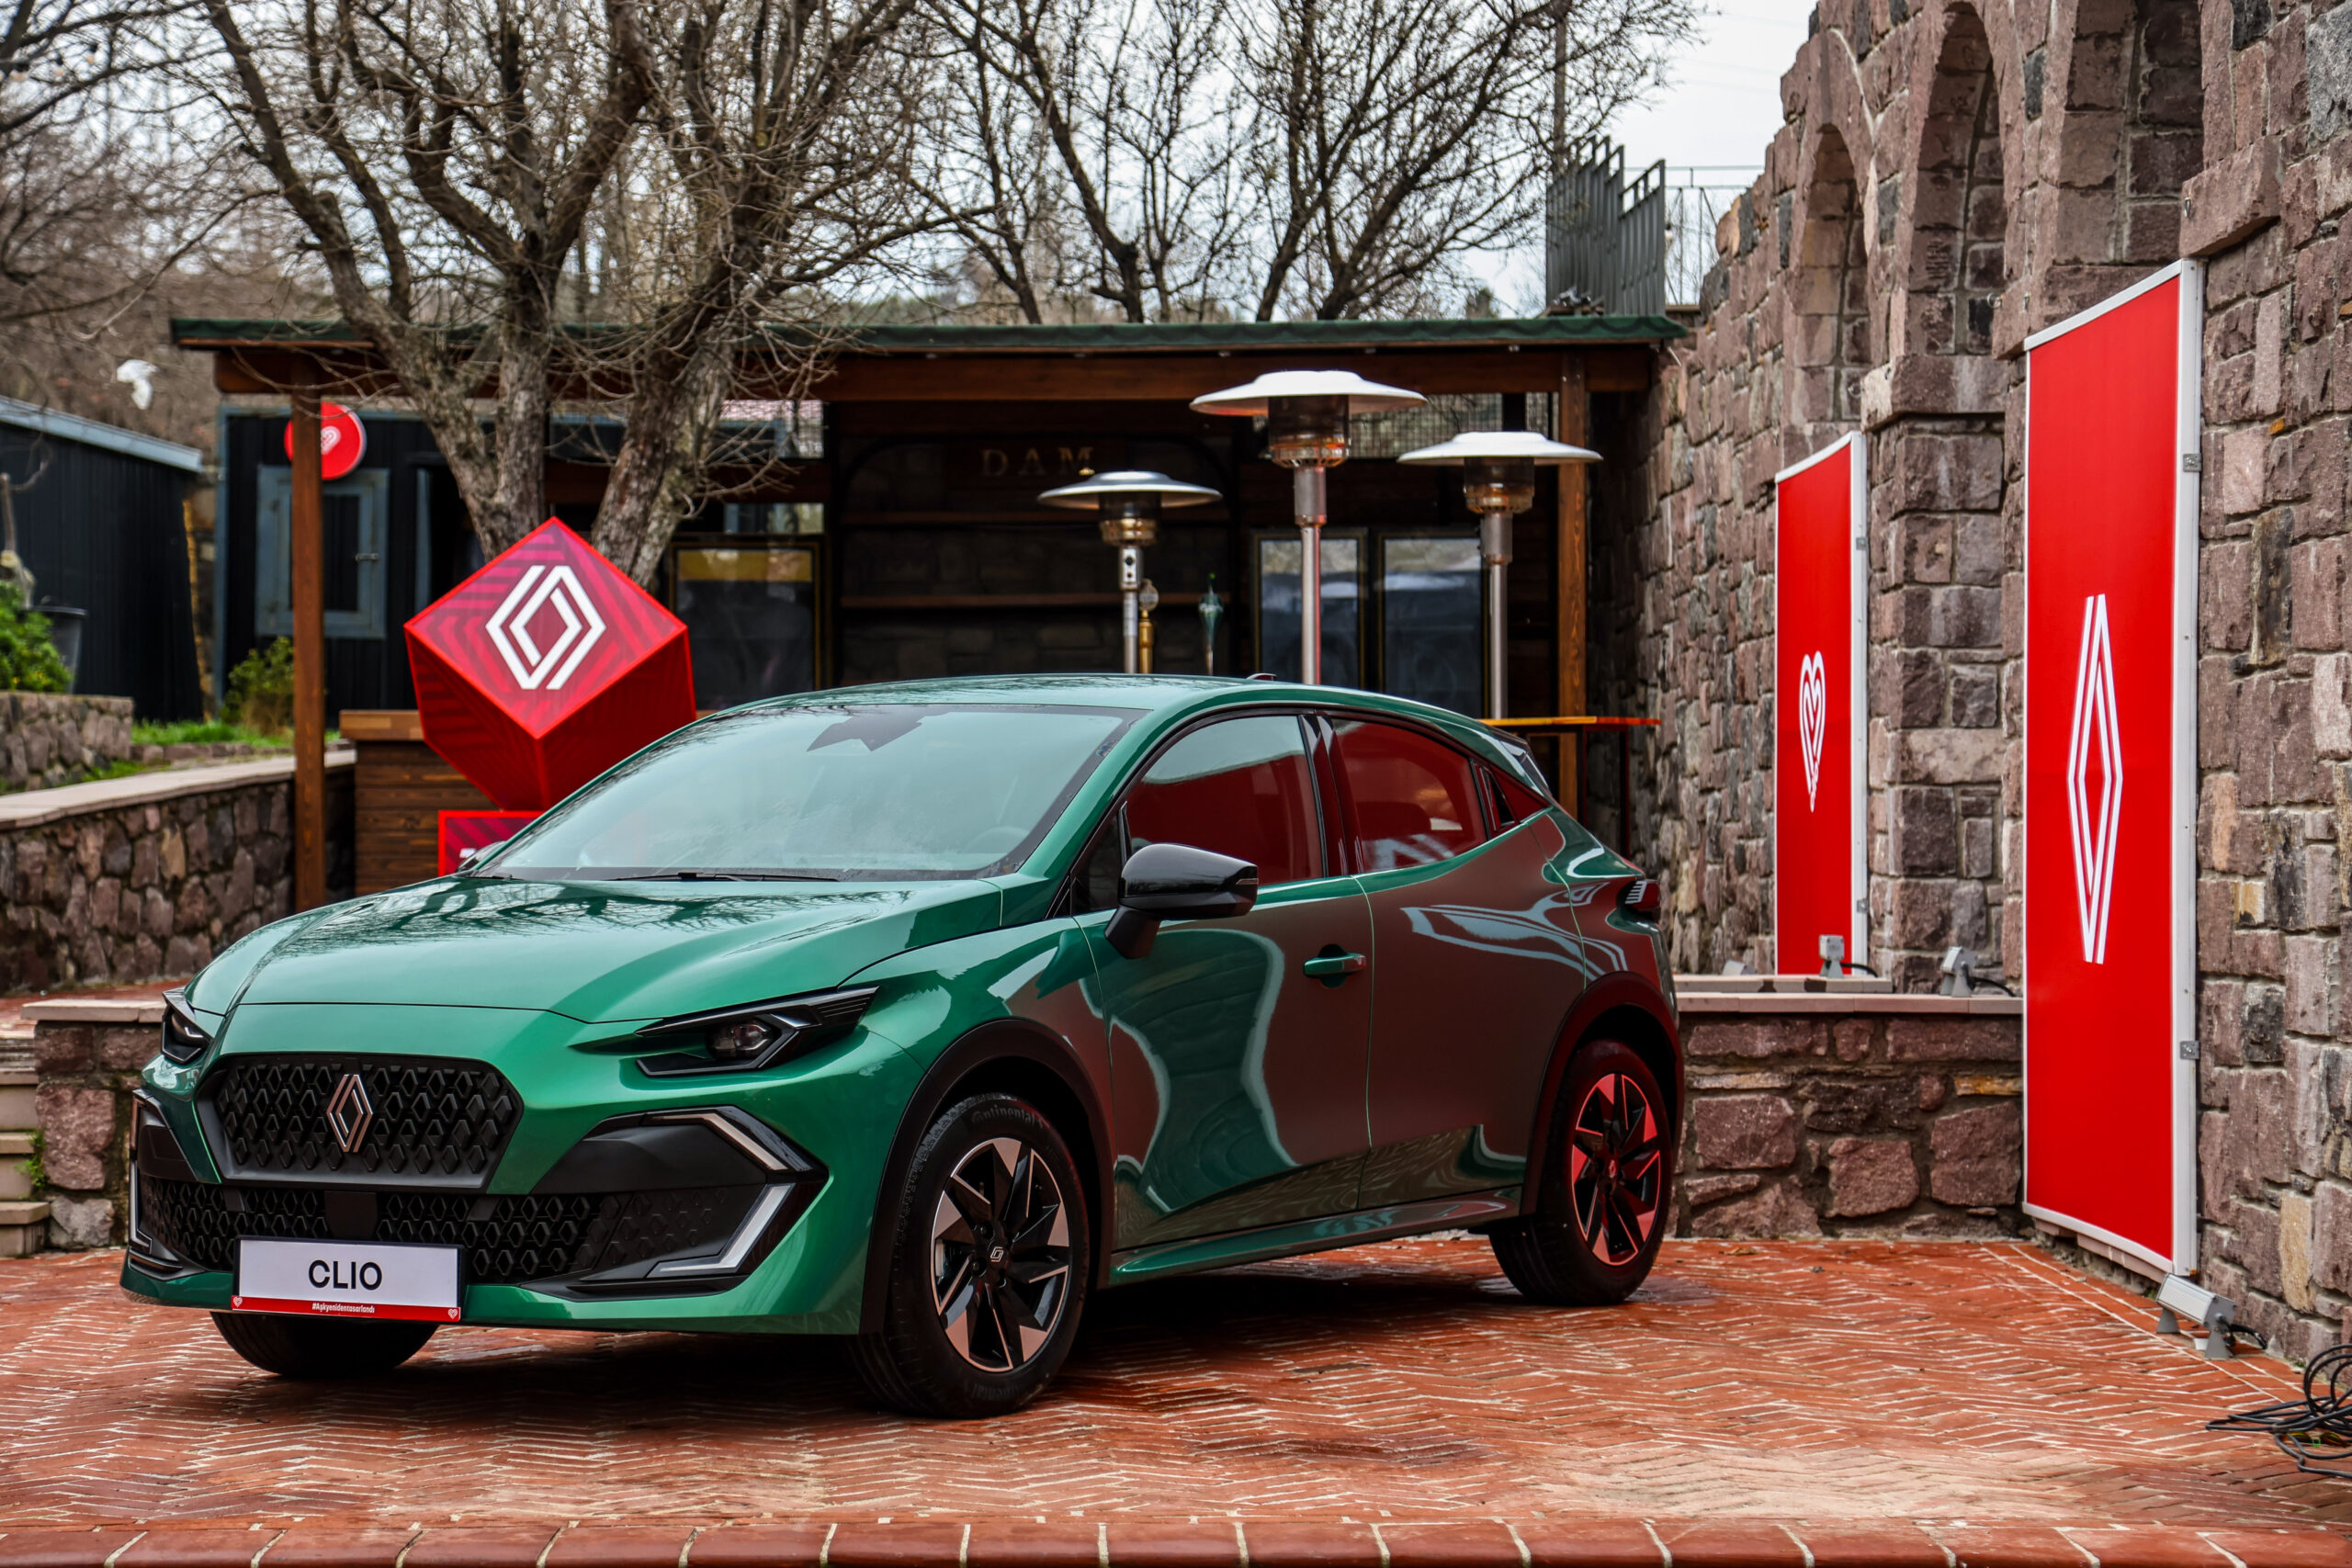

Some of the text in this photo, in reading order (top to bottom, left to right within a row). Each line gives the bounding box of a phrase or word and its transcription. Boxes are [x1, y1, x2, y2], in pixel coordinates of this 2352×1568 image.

[981, 446, 1092, 477] DAM
[971, 1104, 1036, 1126] Continental
[309, 1259, 382, 1291] CLIO
